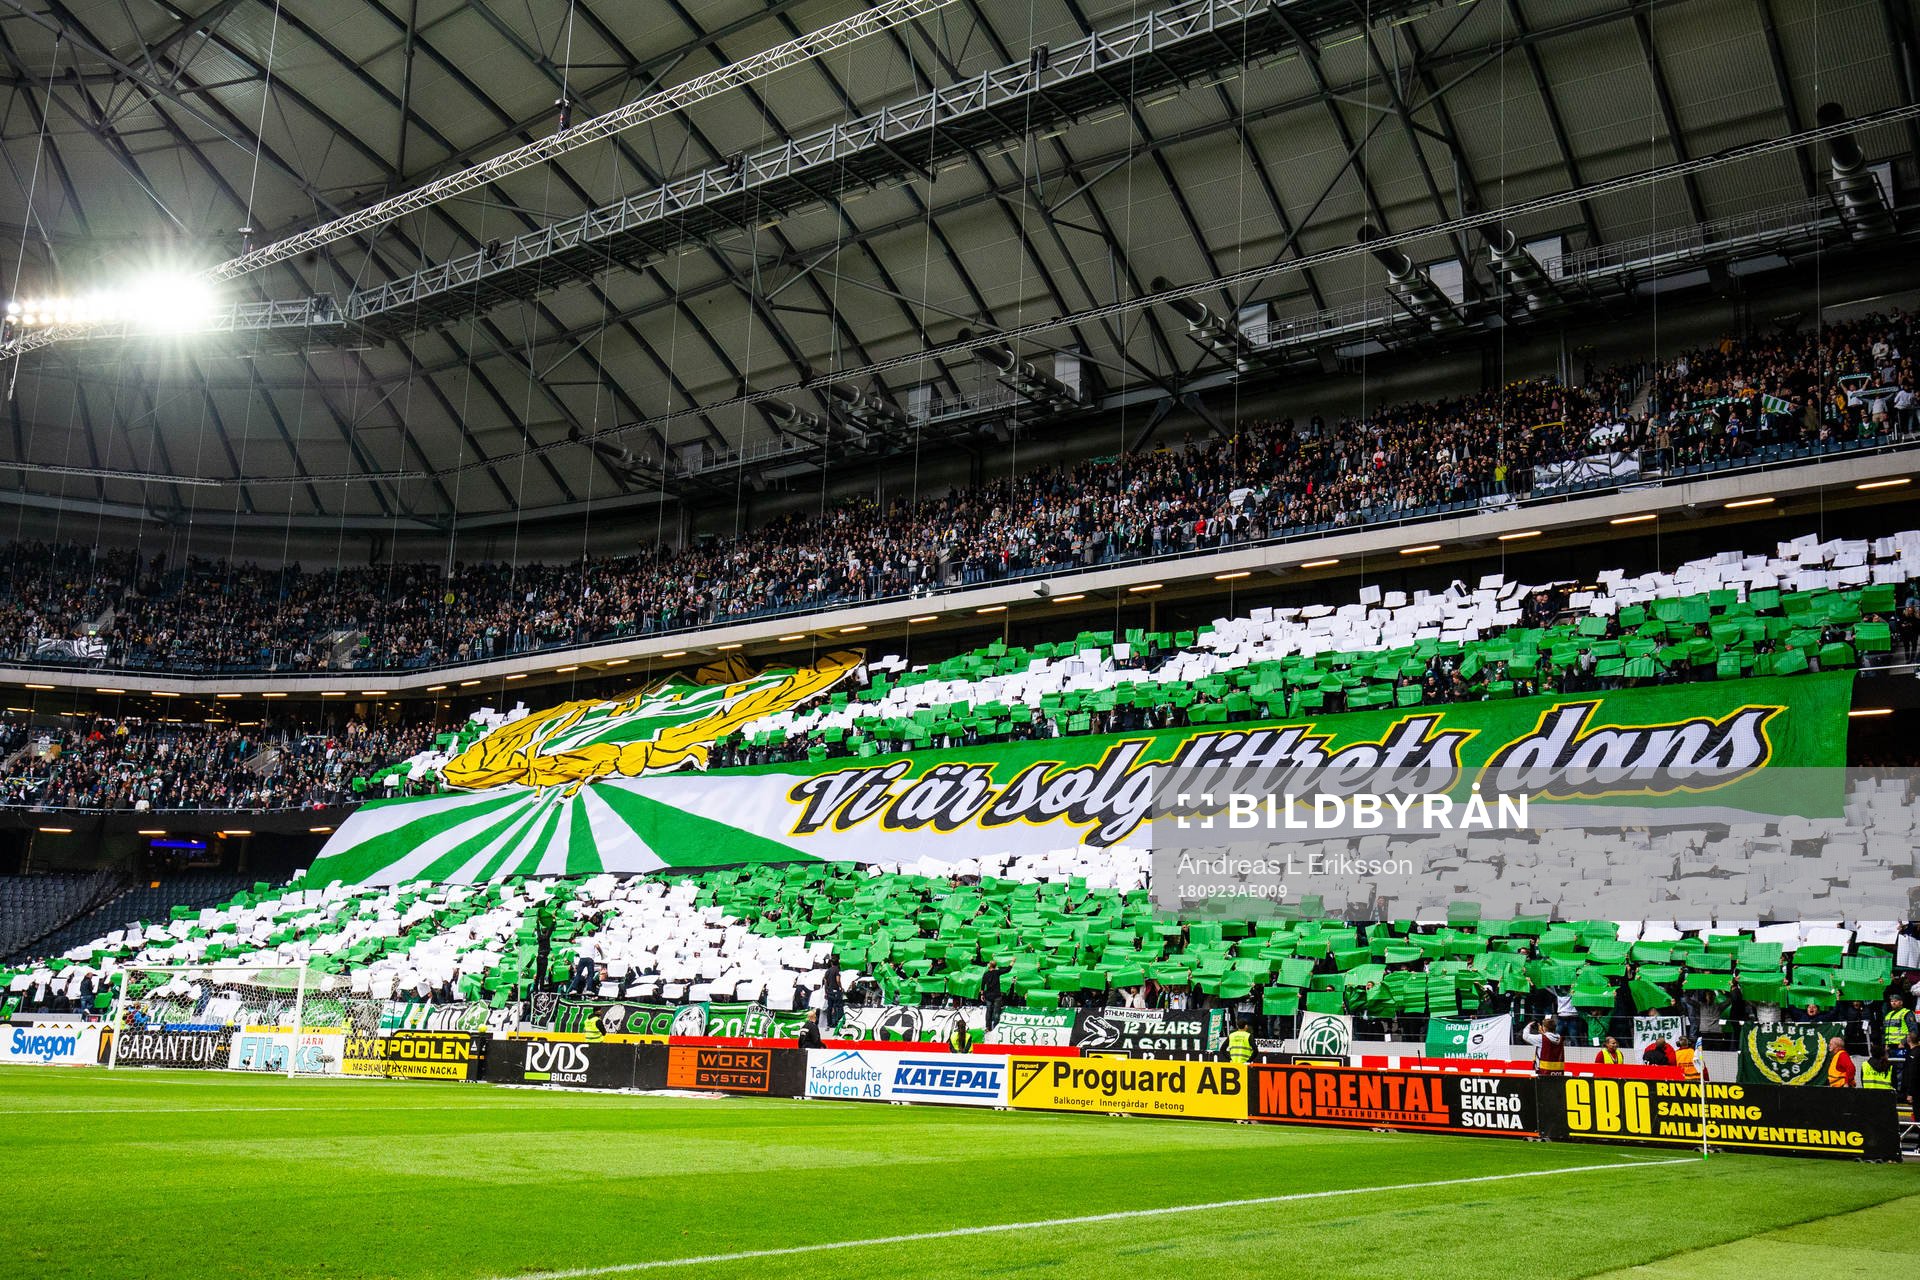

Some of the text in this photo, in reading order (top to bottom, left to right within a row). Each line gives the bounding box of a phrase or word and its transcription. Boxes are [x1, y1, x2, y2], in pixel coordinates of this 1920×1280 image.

[788, 700, 1789, 848] Vi är solglittrets dans
[1124, 1021, 1202, 1035] 12 YEARS
[1635, 1018, 1679, 1031] BAJEN
[10, 1028, 76, 1061] Swegon
[525, 1042, 590, 1073] RYDS
[701, 1053, 764, 1068] WORK
[430, 1065, 458, 1076] NACKA
[551, 1072, 587, 1083] BILGLAS
[700, 1073, 761, 1084] SYSTEM
[810, 1066, 882, 1082] Takprodukter
[894, 1067, 1001, 1090] KATEPAL
[1053, 1061, 1241, 1097] Proguard AB
[809, 1081, 882, 1097] Norden AB
[1460, 1077, 1500, 1094] CITY
[1656, 1081, 1745, 1100] RIVNING
[1053, 1096, 1185, 1112] Balkonger Innergårdar Betong
[1461, 1094, 1522, 1112] EKERÖ
[1565, 1079, 1651, 1134] SBG
[1657, 1101, 1762, 1121] SANERING
[1327, 1108, 1427, 1120] MASKINUTHYRNING
[1461, 1111, 1524, 1130] SOLNA
[1659, 1120, 1865, 1146] MILJÖINVENTERING
